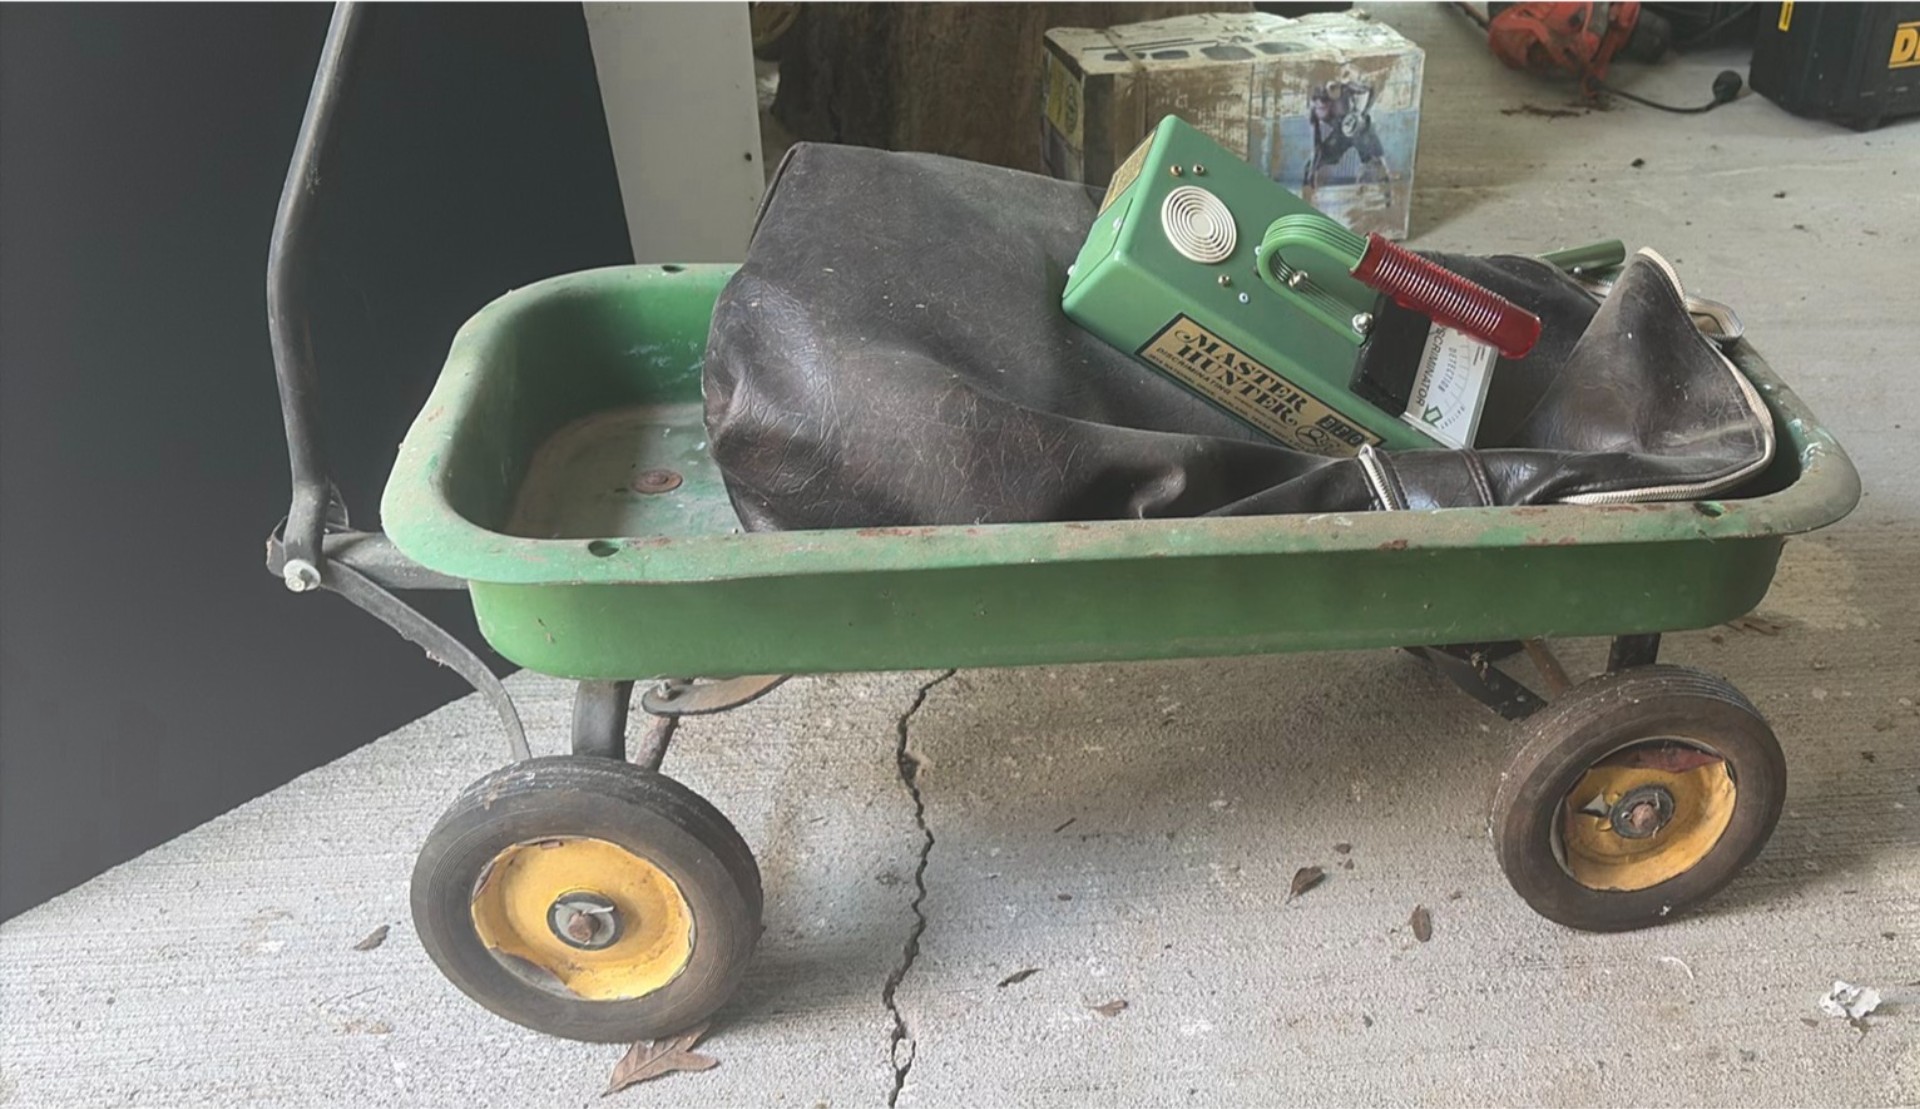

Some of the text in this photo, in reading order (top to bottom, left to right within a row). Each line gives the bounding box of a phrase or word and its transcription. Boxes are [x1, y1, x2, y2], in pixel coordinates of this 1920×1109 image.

[1155, 346, 1232, 396] DISCRIMINATING
[1174, 329, 1307, 413] MASTER
[1177, 344, 1298, 426] HUNTER
[1416, 327, 1446, 407] SCRIMINATOR
[1438, 346, 1458, 392] DETECTION
